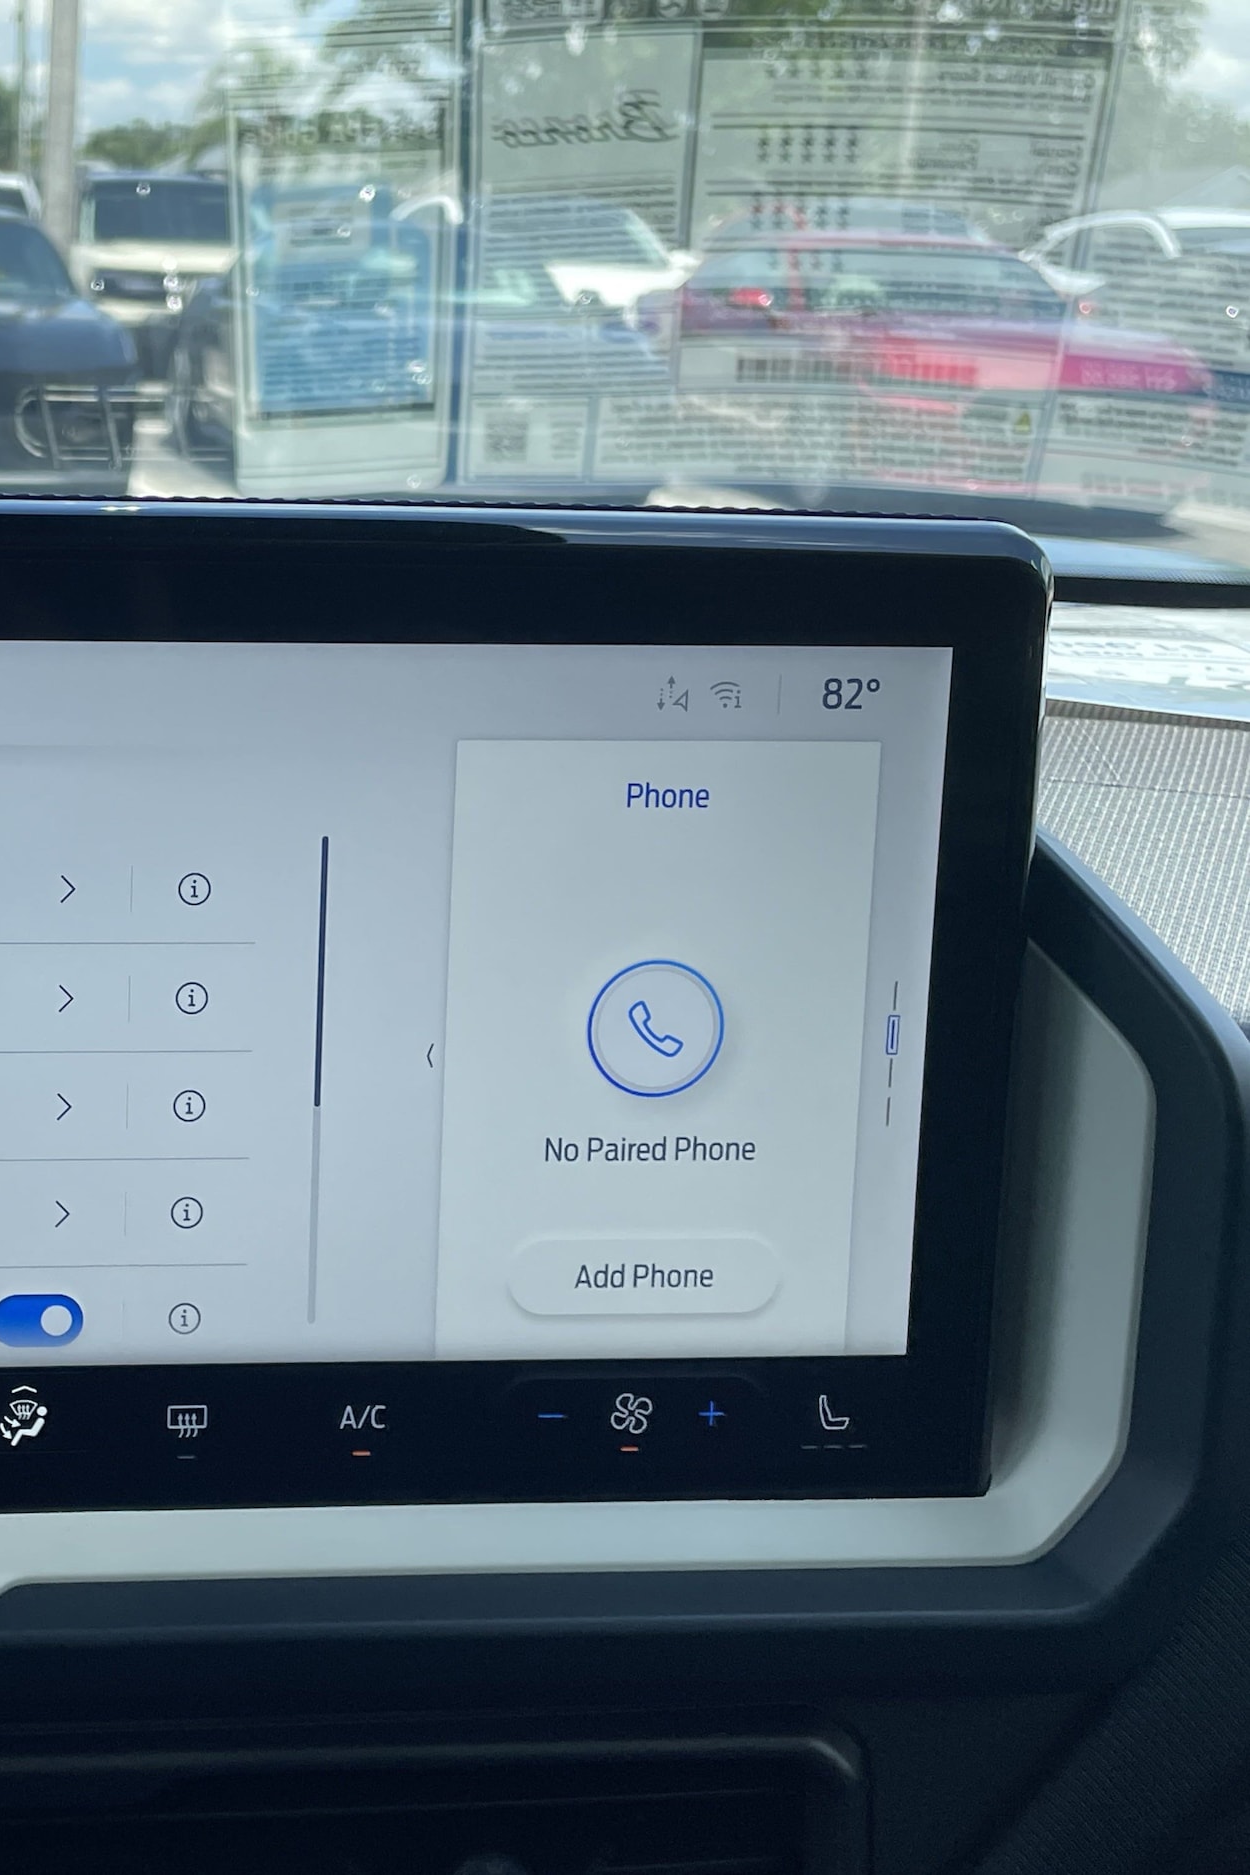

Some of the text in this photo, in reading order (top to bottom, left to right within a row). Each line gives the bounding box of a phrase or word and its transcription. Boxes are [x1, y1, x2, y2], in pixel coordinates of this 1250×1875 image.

[822, 677, 881, 710] 82°
[626, 781, 710, 809] Phone
[544, 1135, 756, 1162] No Paired Phone
[574, 1263, 714, 1289] Add Phone
[339, 1404, 387, 1430] A/C
